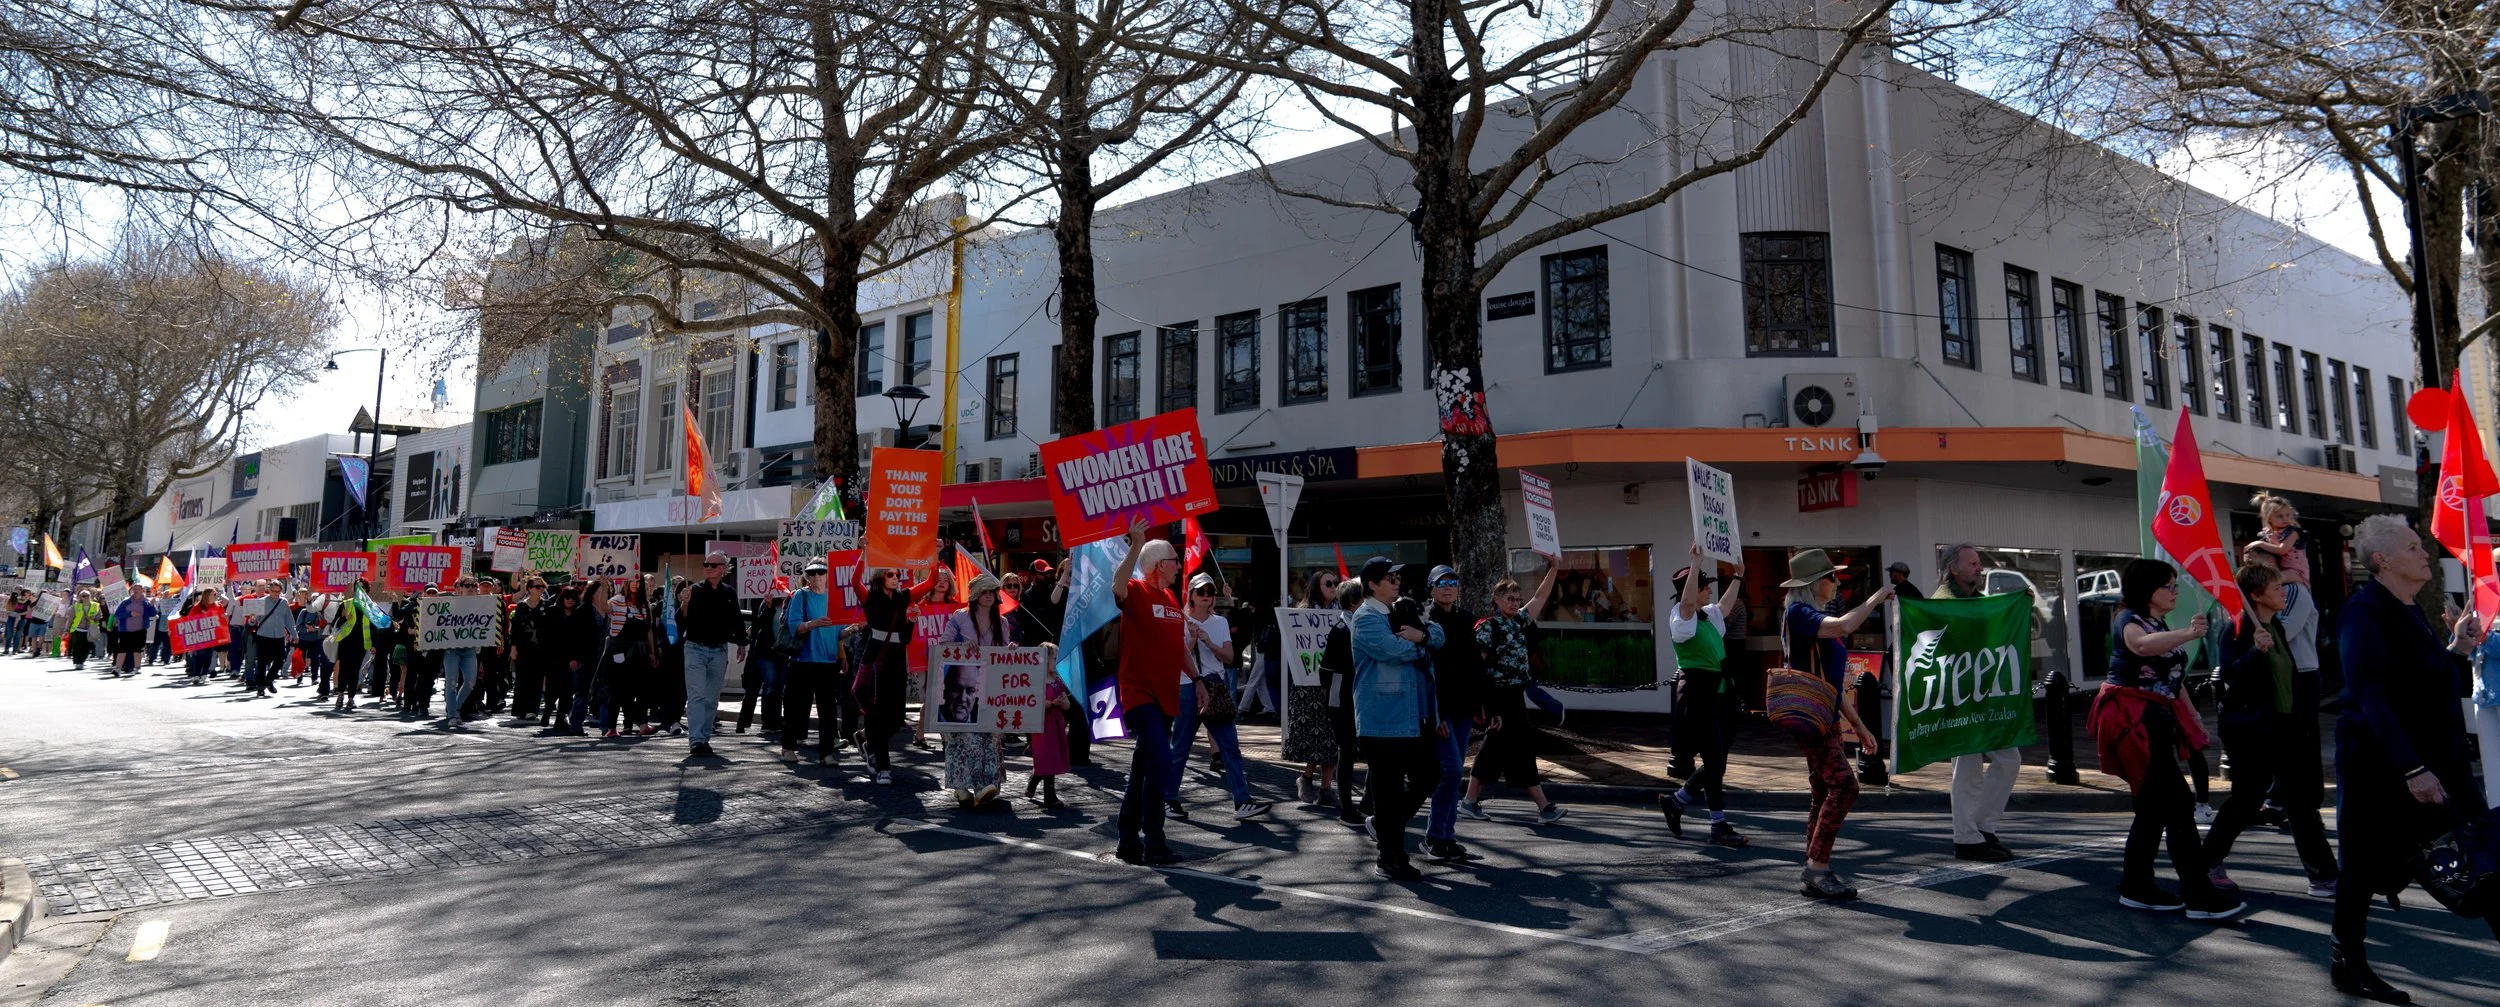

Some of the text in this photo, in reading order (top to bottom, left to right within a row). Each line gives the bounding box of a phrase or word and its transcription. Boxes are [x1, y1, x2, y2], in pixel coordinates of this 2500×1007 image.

[961, 408, 976, 418] UDC
[1784, 437, 1853, 451] TANK
[1057, 431, 1197, 490] WOMEN ARE
[1290, 455, 1304, 476] &
[1307, 453, 1337, 477] SPA
[885, 469, 928, 482] THANK
[889, 483, 921, 495] YOUS
[1079, 464, 1188, 516] WORTH IT
[1713, 473, 1725, 496] THE
[1525, 491, 1552, 508] TOGETHER
[1799, 478, 1840, 507] TANK
[178, 493, 204, 520] Farmers
[886, 497, 924, 509] DON'T
[879, 511, 927, 523] PAY THE
[1533, 512, 1551, 526] PROUD
[819, 521, 859, 538] ABOUT
[887, 525, 919, 536] BILLS
[1536, 522, 1550, 534] TO BE
[527, 532, 572, 548] PAY PAY
[590, 536, 638, 551] TRUST
[1536, 532, 1554, 543] UNION
[1706, 531, 1731, 556] GENDER
[231, 548, 286, 562] WOMEN ARE
[399, 552, 452, 568] PAY HER
[528, 547, 572, 563] EQUITY
[601, 554, 612, 563] is
[237, 559, 280, 573] WORTH IT
[322, 557, 369, 572] PAY HER
[535, 559, 565, 571] NOW
[587, 563, 627, 577] DEAD
[740, 559, 747, 568] I
[750, 558, 762, 567] AM
[199, 576, 223, 584] PAY US
[405, 567, 444, 584] RIGHT
[746, 569, 767, 577] HEAR
[744, 579, 783, 595] ROA
[427, 602, 450, 615] OUR
[177, 615, 220, 635] PAY HER
[436, 614, 494, 627] DEMOCRACY
[918, 614, 946, 637] PAY
[1289, 613, 1303, 628] I
[1305, 613, 1334, 629] VOTE
[185, 628, 217, 646] RIGHT
[425, 627, 490, 643] OUR VOICE
[1296, 634, 1312, 649] MY
[990, 651, 1040, 666] THANKS
[1905, 624, 2021, 716] Green
[1002, 673, 1032, 689] FOR
[987, 694, 1038, 707] NOTHING
[1969, 711, 1985, 725] New
[1988, 706, 2017, 722] Zealan
